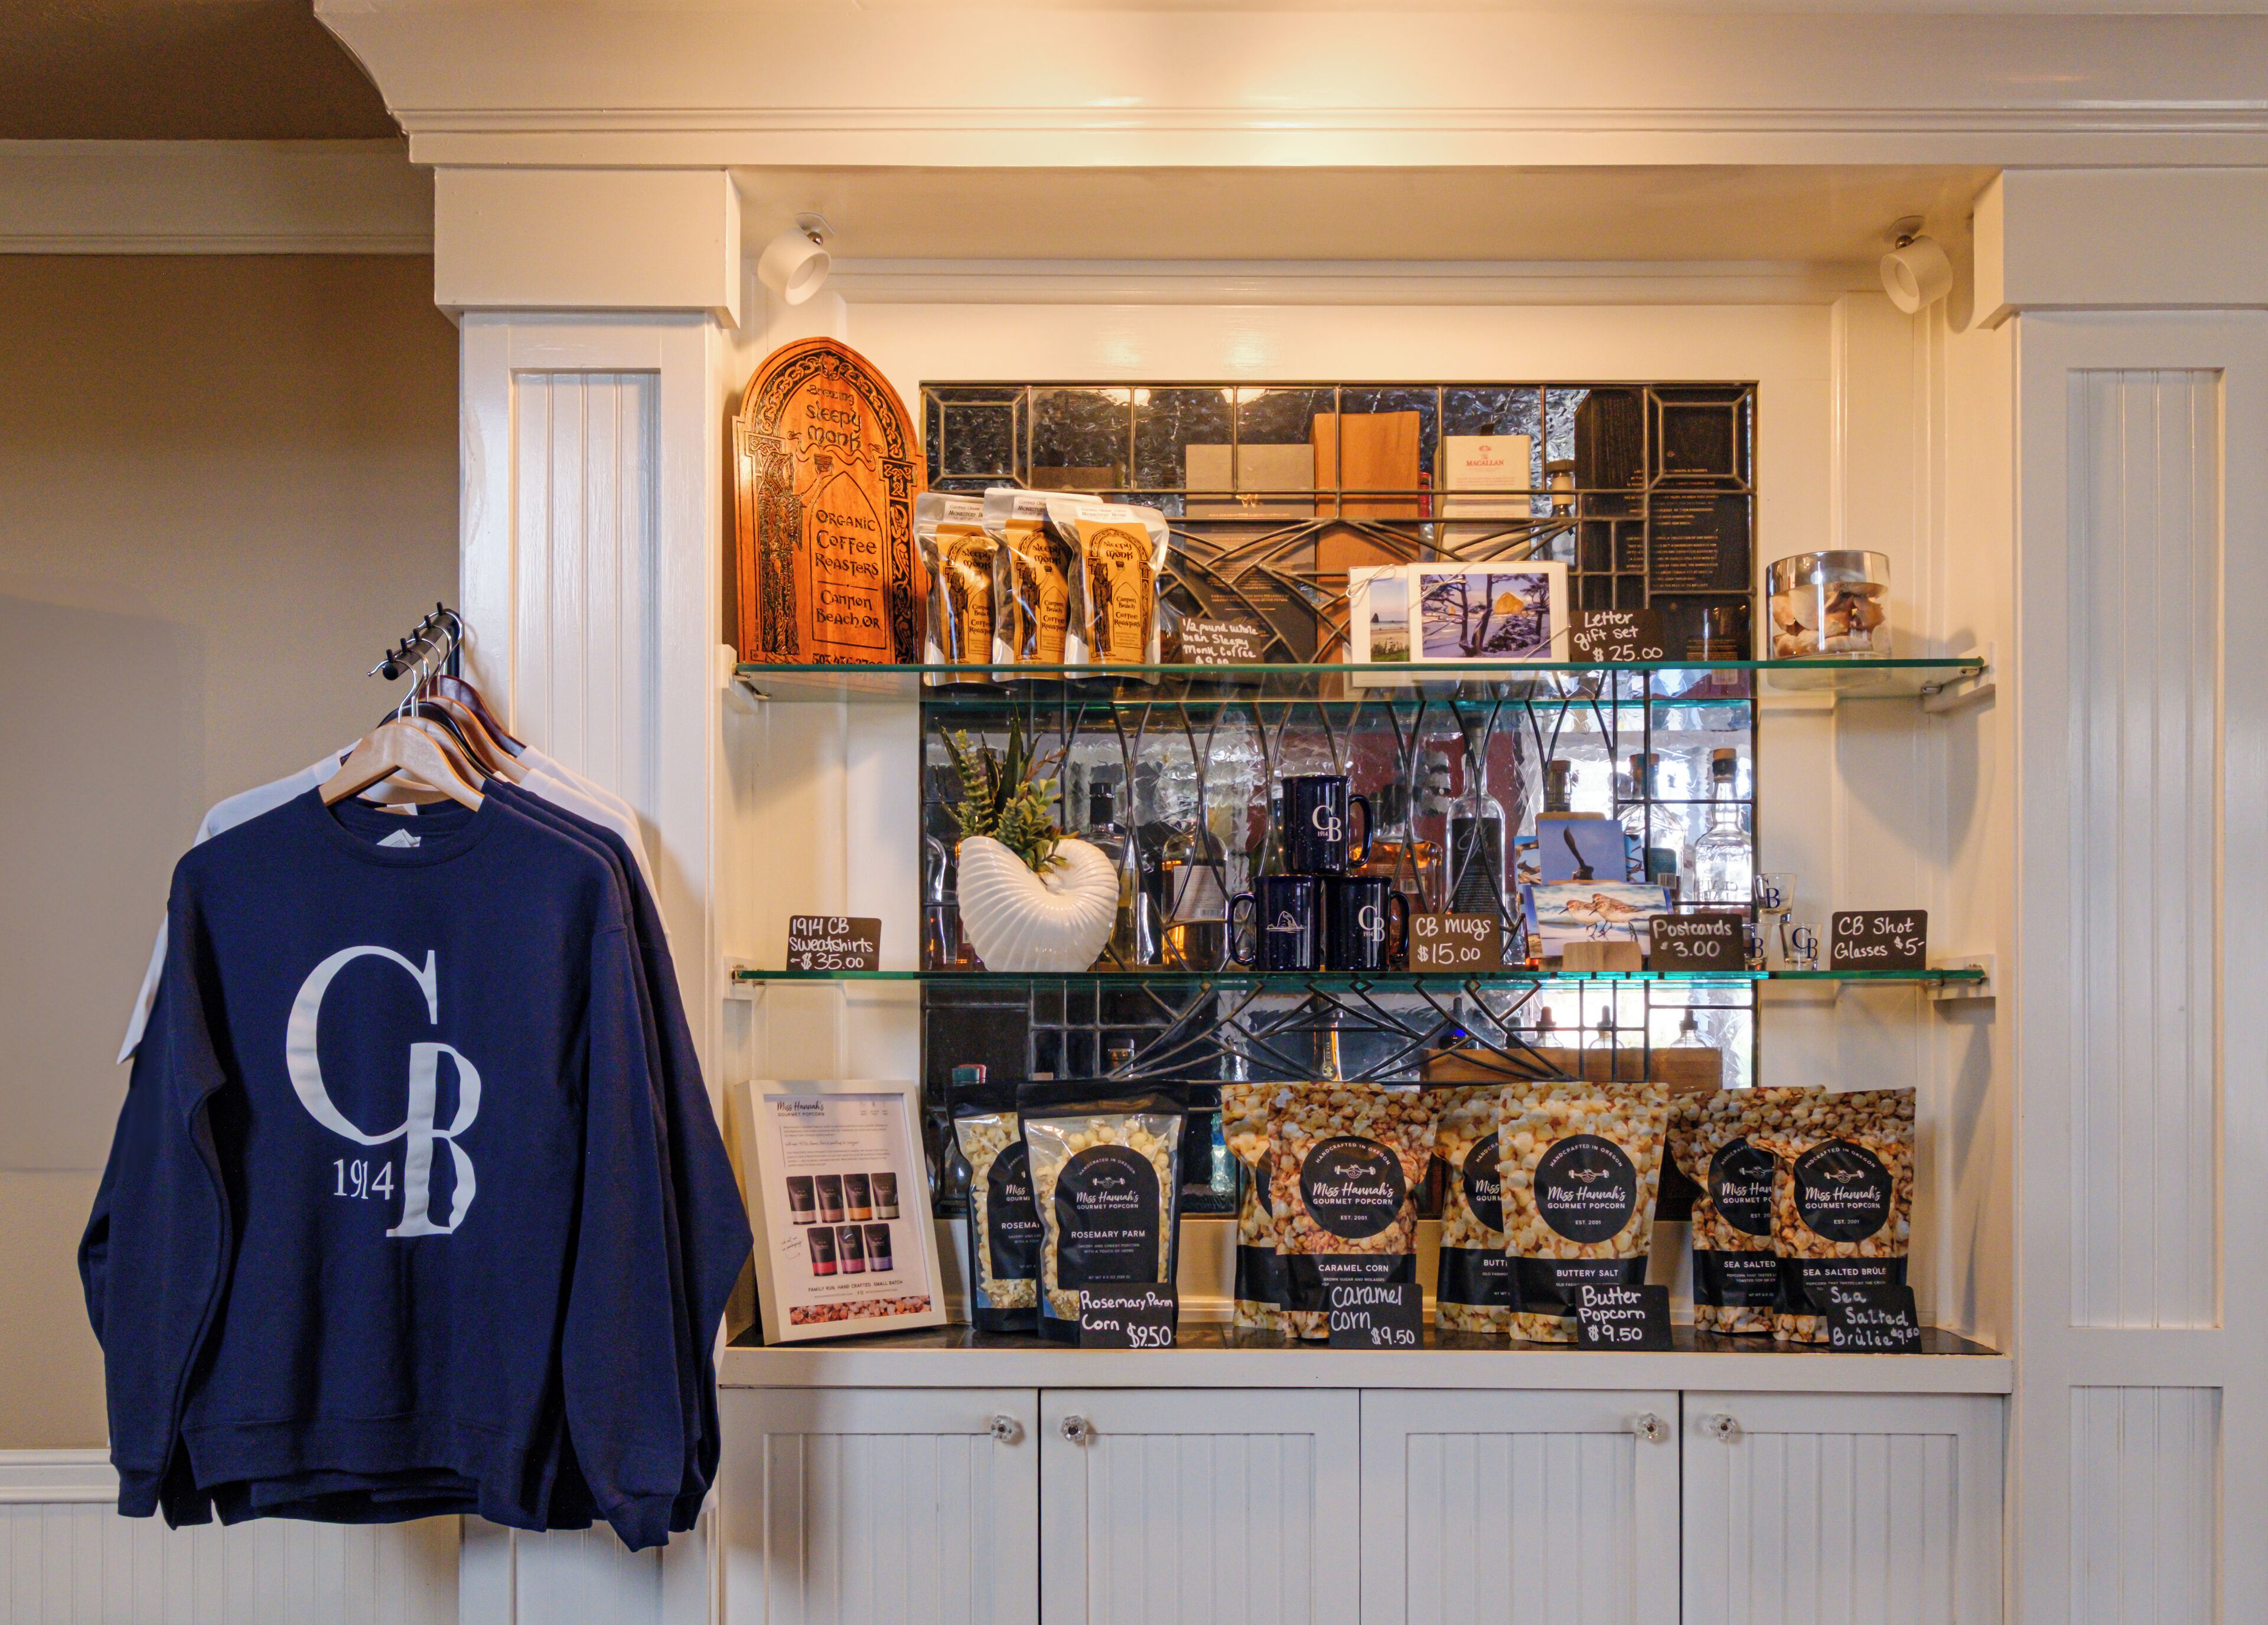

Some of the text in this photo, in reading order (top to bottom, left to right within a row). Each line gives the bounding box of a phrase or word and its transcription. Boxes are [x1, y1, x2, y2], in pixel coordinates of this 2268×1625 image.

[1182, 618, 1200, 632] 1/2
[1199, 622, 1228, 635] pound
[1229, 624, 1259, 635] whole
[1584, 611, 1634, 628] Letter
[1182, 632, 1250, 650] bean Sleepy
[1573, 625, 1639, 651] gift set
[1195, 655, 1230, 664] $900
[1219, 644, 1257, 658] Coffee
[1592, 644, 1663, 663] $25.00
[1312, 805, 1342, 842] CB
[1755, 877, 1781, 909] CB
[793, 917, 849, 937] 1914 CB
[1358, 905, 1386, 942] CB
[1416, 916, 1491, 941] CB mugs
[1653, 919, 1733, 939] Postcards
[1838, 915, 1915, 935] CB Shot
[1792, 927, 1818, 959] CB
[1834, 940, 1888, 960] Glasses
[800, 952, 865, 970] $35.00
[1418, 942, 1481, 965] $15.00
[286, 945, 482, 1238] CB
[777, 1101, 825, 1111] Miss Hannah's
[1007, 1154, 1024, 1169] HANDCR
[1315, 1142, 1357, 1164] HANDCRAFTED
[1367, 1147, 1391, 1166] OREGON
[1475, 1142, 1499, 1163] HANDCRA
[1549, 1143, 1590, 1168] HANDCRAFTED
[1600, 1147, 1623, 1168] OREGON
[1851, 1150, 1876, 1169] OREGON
[1117, 1159, 1136, 1175] OREGON
[333, 1159, 395, 1200] 1914
[1475, 1179, 1500, 1194] Miss
[1722, 1182, 1772, 1196] Miss Han
[1005, 1183, 1026, 1196] Miss
[1076, 1190, 1139, 1204] Miss Hannah's
[1312, 1181, 1394, 1198] Miss Hannah's
[1547, 1185, 1627, 1202] Miss Hannah's
[1805, 1185, 1882, 1202] Miss Hannah's
[1355, 1197, 1393, 1206] POPCORN
[1001, 1221, 1040, 1230] ROSEMA
[1071, 1229, 1146, 1239] ROSEMARY PARM
[1744, 1260, 1777, 1268] SALTED
[1803, 1268, 1821, 1277] SEA
[1080, 1290, 1173, 1311] Rosemary Parm
[1582, 1285, 1641, 1307] Butter
[1831, 1286, 1867, 1304] Sea
[1578, 1307, 1645, 1325] Popcorn
[1845, 1306, 1909, 1327] Salted
[1081, 1313, 1172, 1349] Corn $9.50
[1370, 1326, 1416, 1345] $9.50
[1587, 1324, 1643, 1343] $9.50
